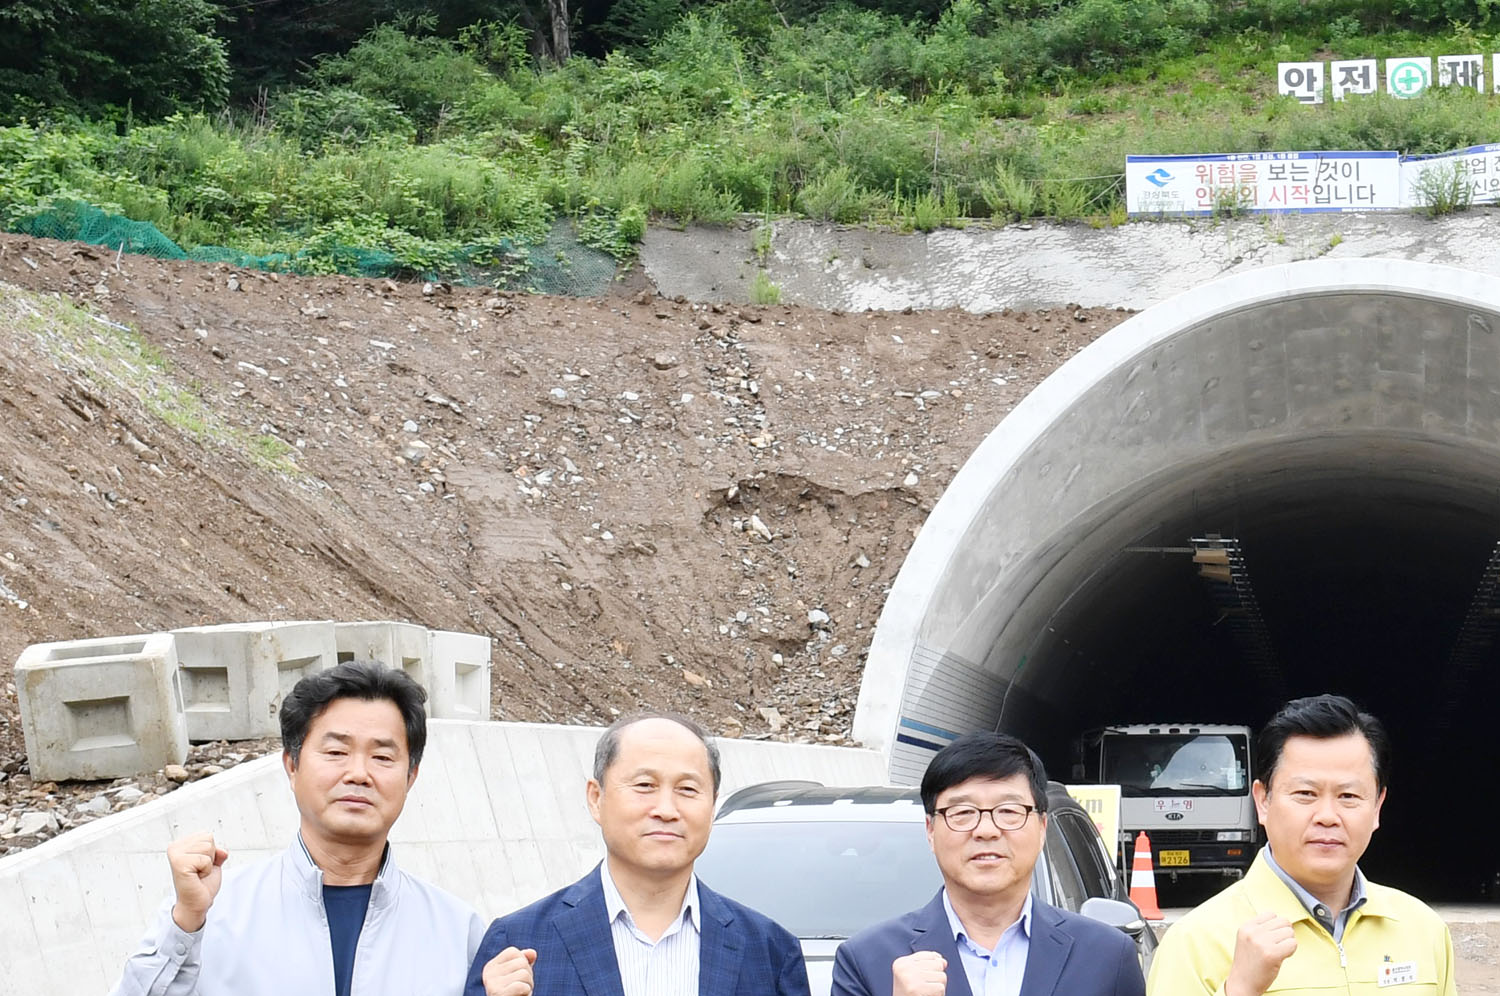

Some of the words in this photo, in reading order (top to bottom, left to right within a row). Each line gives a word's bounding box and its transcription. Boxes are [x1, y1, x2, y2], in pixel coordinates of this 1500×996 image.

[1284, 66, 1371, 101] 안전
[1195, 163, 1258, 184] 위험을
[1267, 161, 1310, 182] 보는
[1319, 160, 1360, 182] 것이
[1268, 184, 1376, 205] 시작입니다
[1167, 856, 1189, 865] 2126
